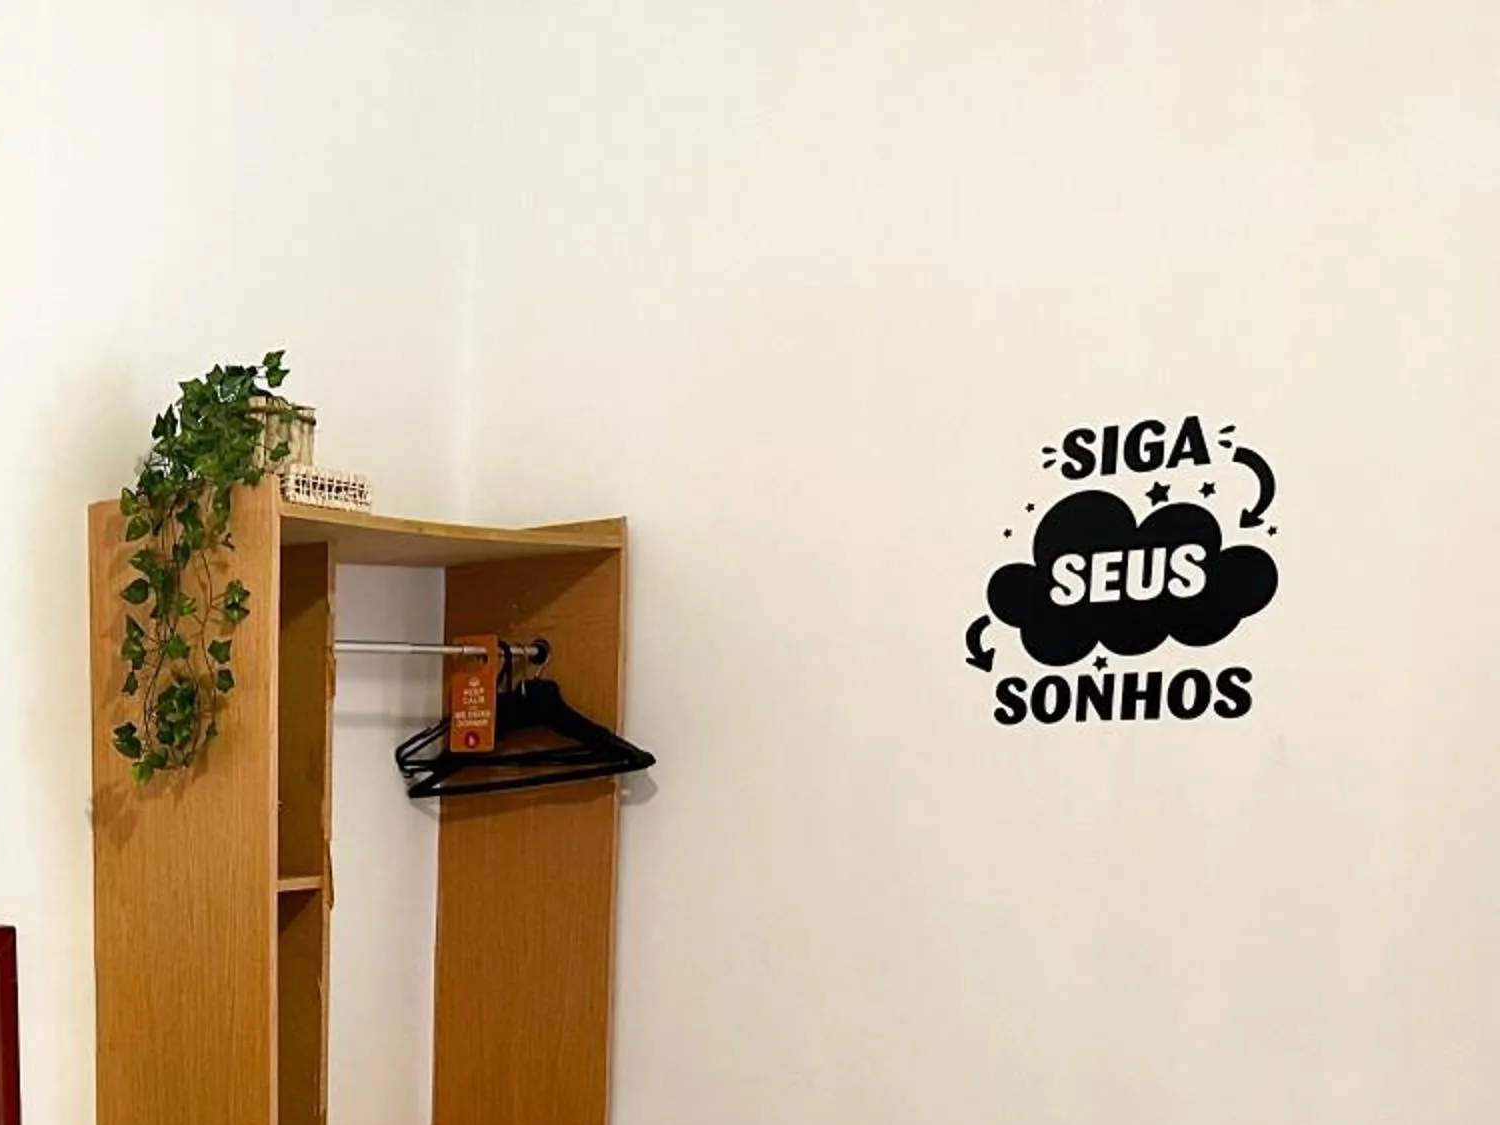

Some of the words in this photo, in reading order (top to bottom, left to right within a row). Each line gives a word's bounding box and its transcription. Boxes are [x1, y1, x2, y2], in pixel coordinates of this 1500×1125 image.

[1060, 415, 1211, 480] SIGA
[1049, 543, 1206, 606] SEUS
[994, 667, 1252, 725] SONHOS
